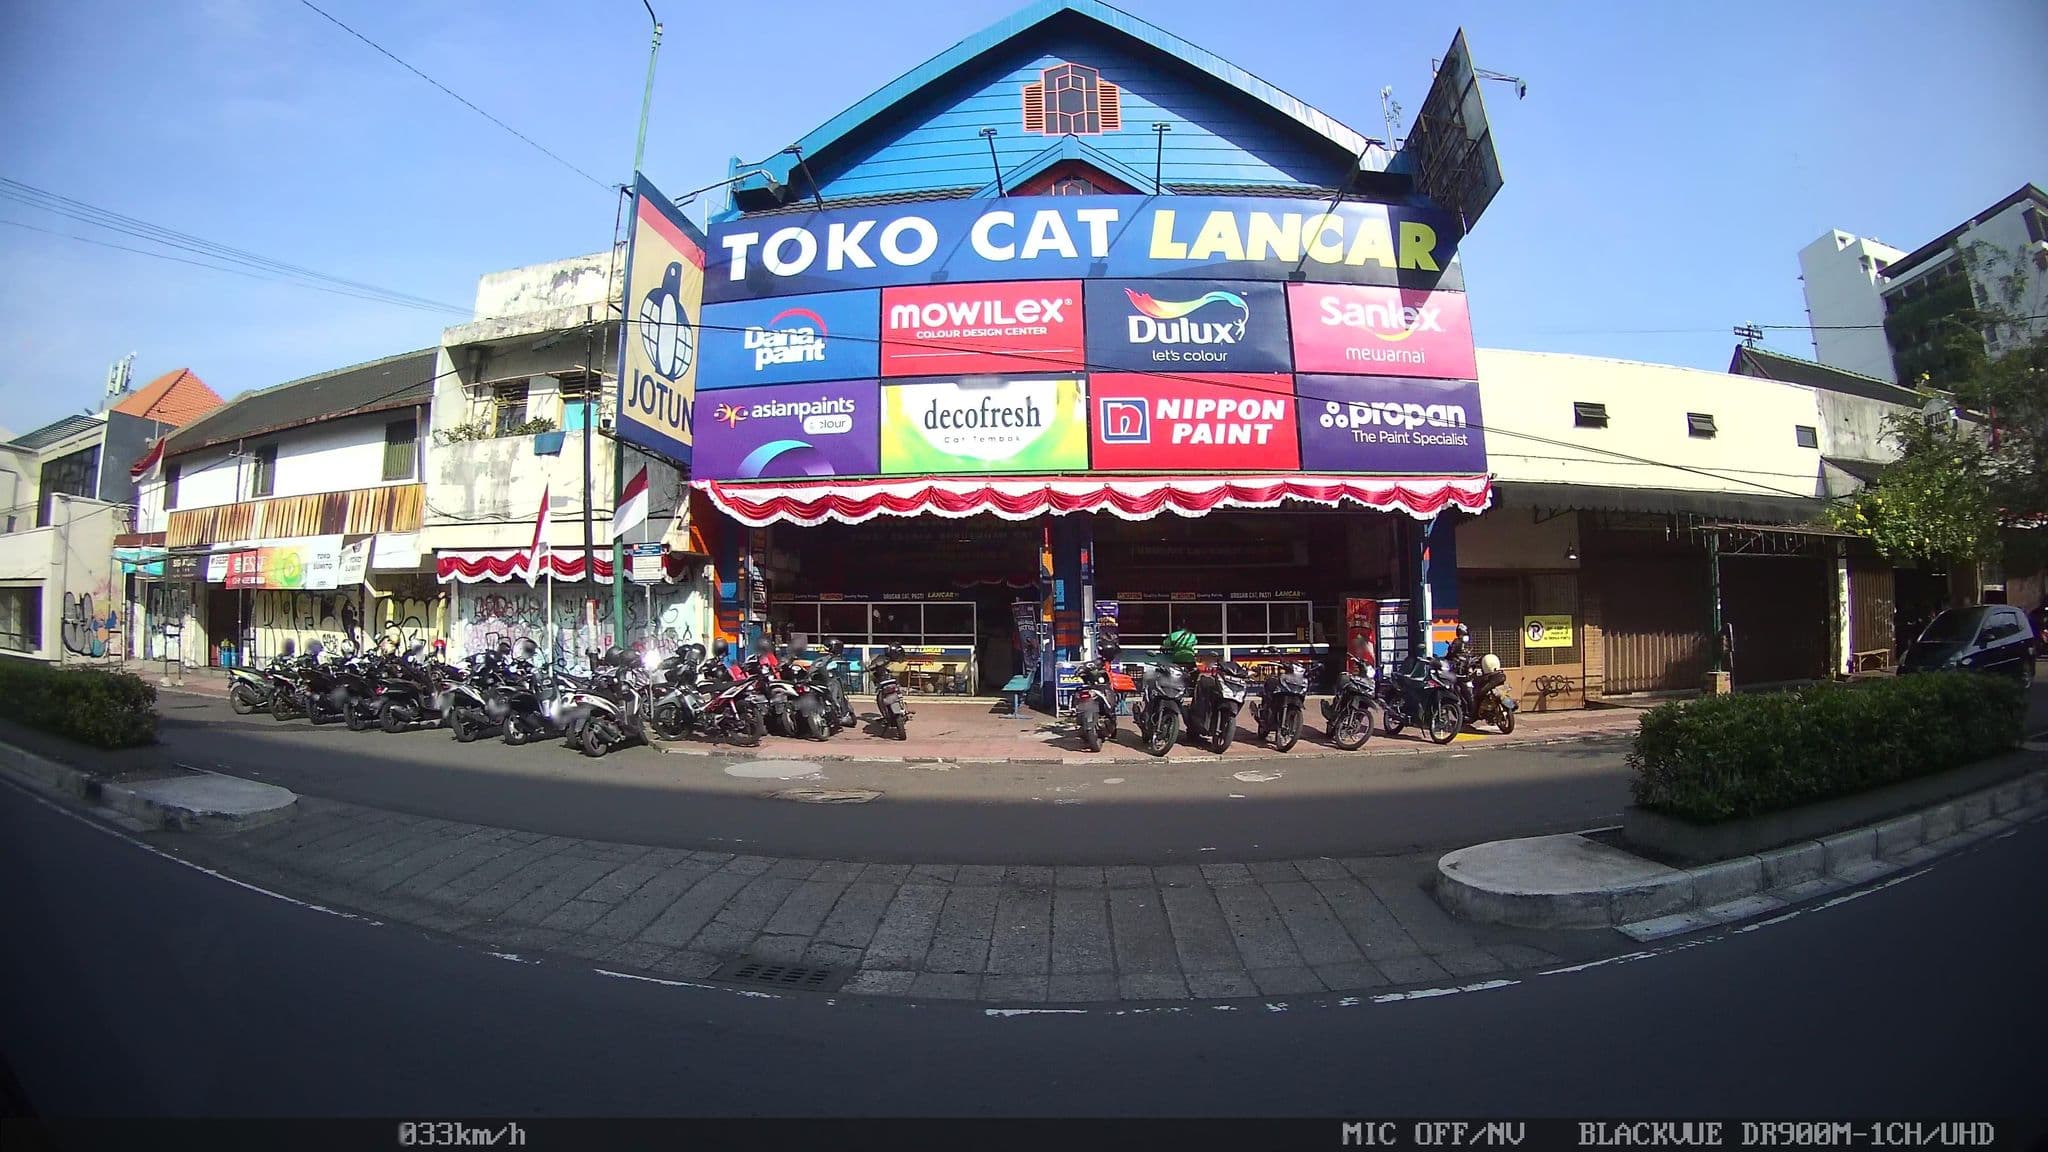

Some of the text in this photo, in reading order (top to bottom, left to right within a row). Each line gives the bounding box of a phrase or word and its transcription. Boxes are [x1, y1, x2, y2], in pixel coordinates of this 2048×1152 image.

[721, 208, 1441, 282] TOKO CAT LANCAR
[1320, 296, 1442, 332] Sanlex
[744, 326, 815, 350] Dana
[916, 326, 1048, 340] COLOUR DESIGN CENTER
[1128, 313, 1236, 346] Dulux
[755, 338, 826, 371] paint
[1152, 350, 1228, 363] let's colour
[1346, 346, 1426, 364] mewarnai
[628, 367, 696, 437] JOTUN
[751, 396, 855, 423] asianpaints
[924, 395, 1042, 430] decofresh
[1156, 398, 1286, 421] NIPPON
[1349, 401, 1467, 430] propan
[1171, 422, 1273, 446] PAINT
[1351, 430, 1469, 446] The Paint Specialist
